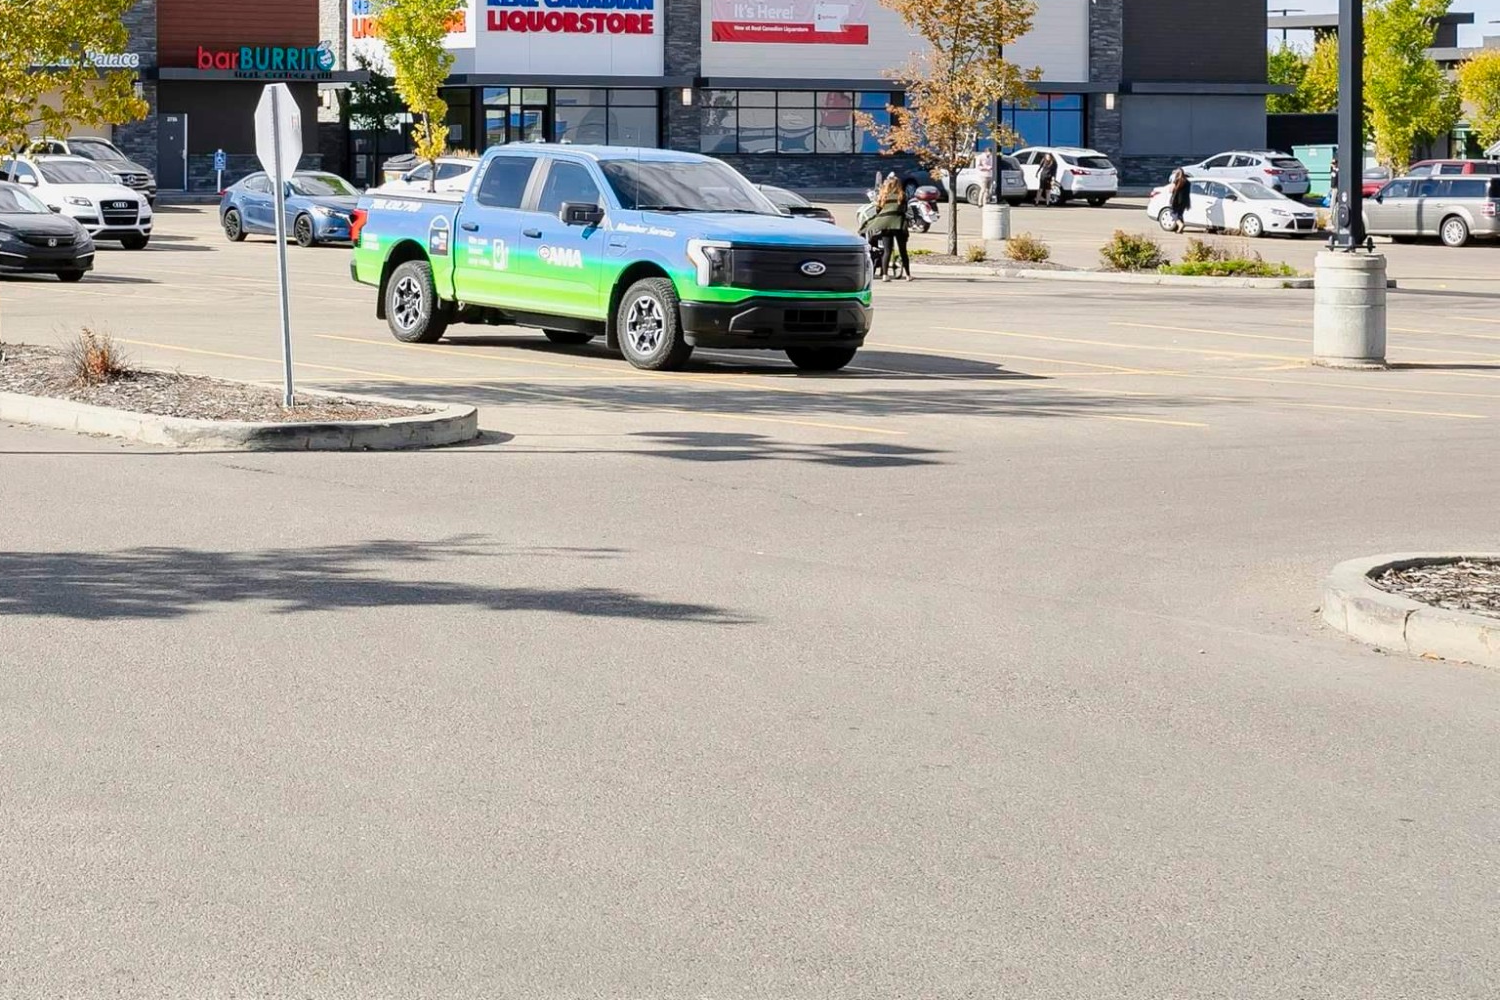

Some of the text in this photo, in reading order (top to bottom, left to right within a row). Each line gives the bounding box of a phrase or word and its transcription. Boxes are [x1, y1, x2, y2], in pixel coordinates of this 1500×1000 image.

[486, 10, 654, 34] LIQUORSTORE
[734, 4, 794, 20] It's Here!
[547, 246, 583, 269] AMA
